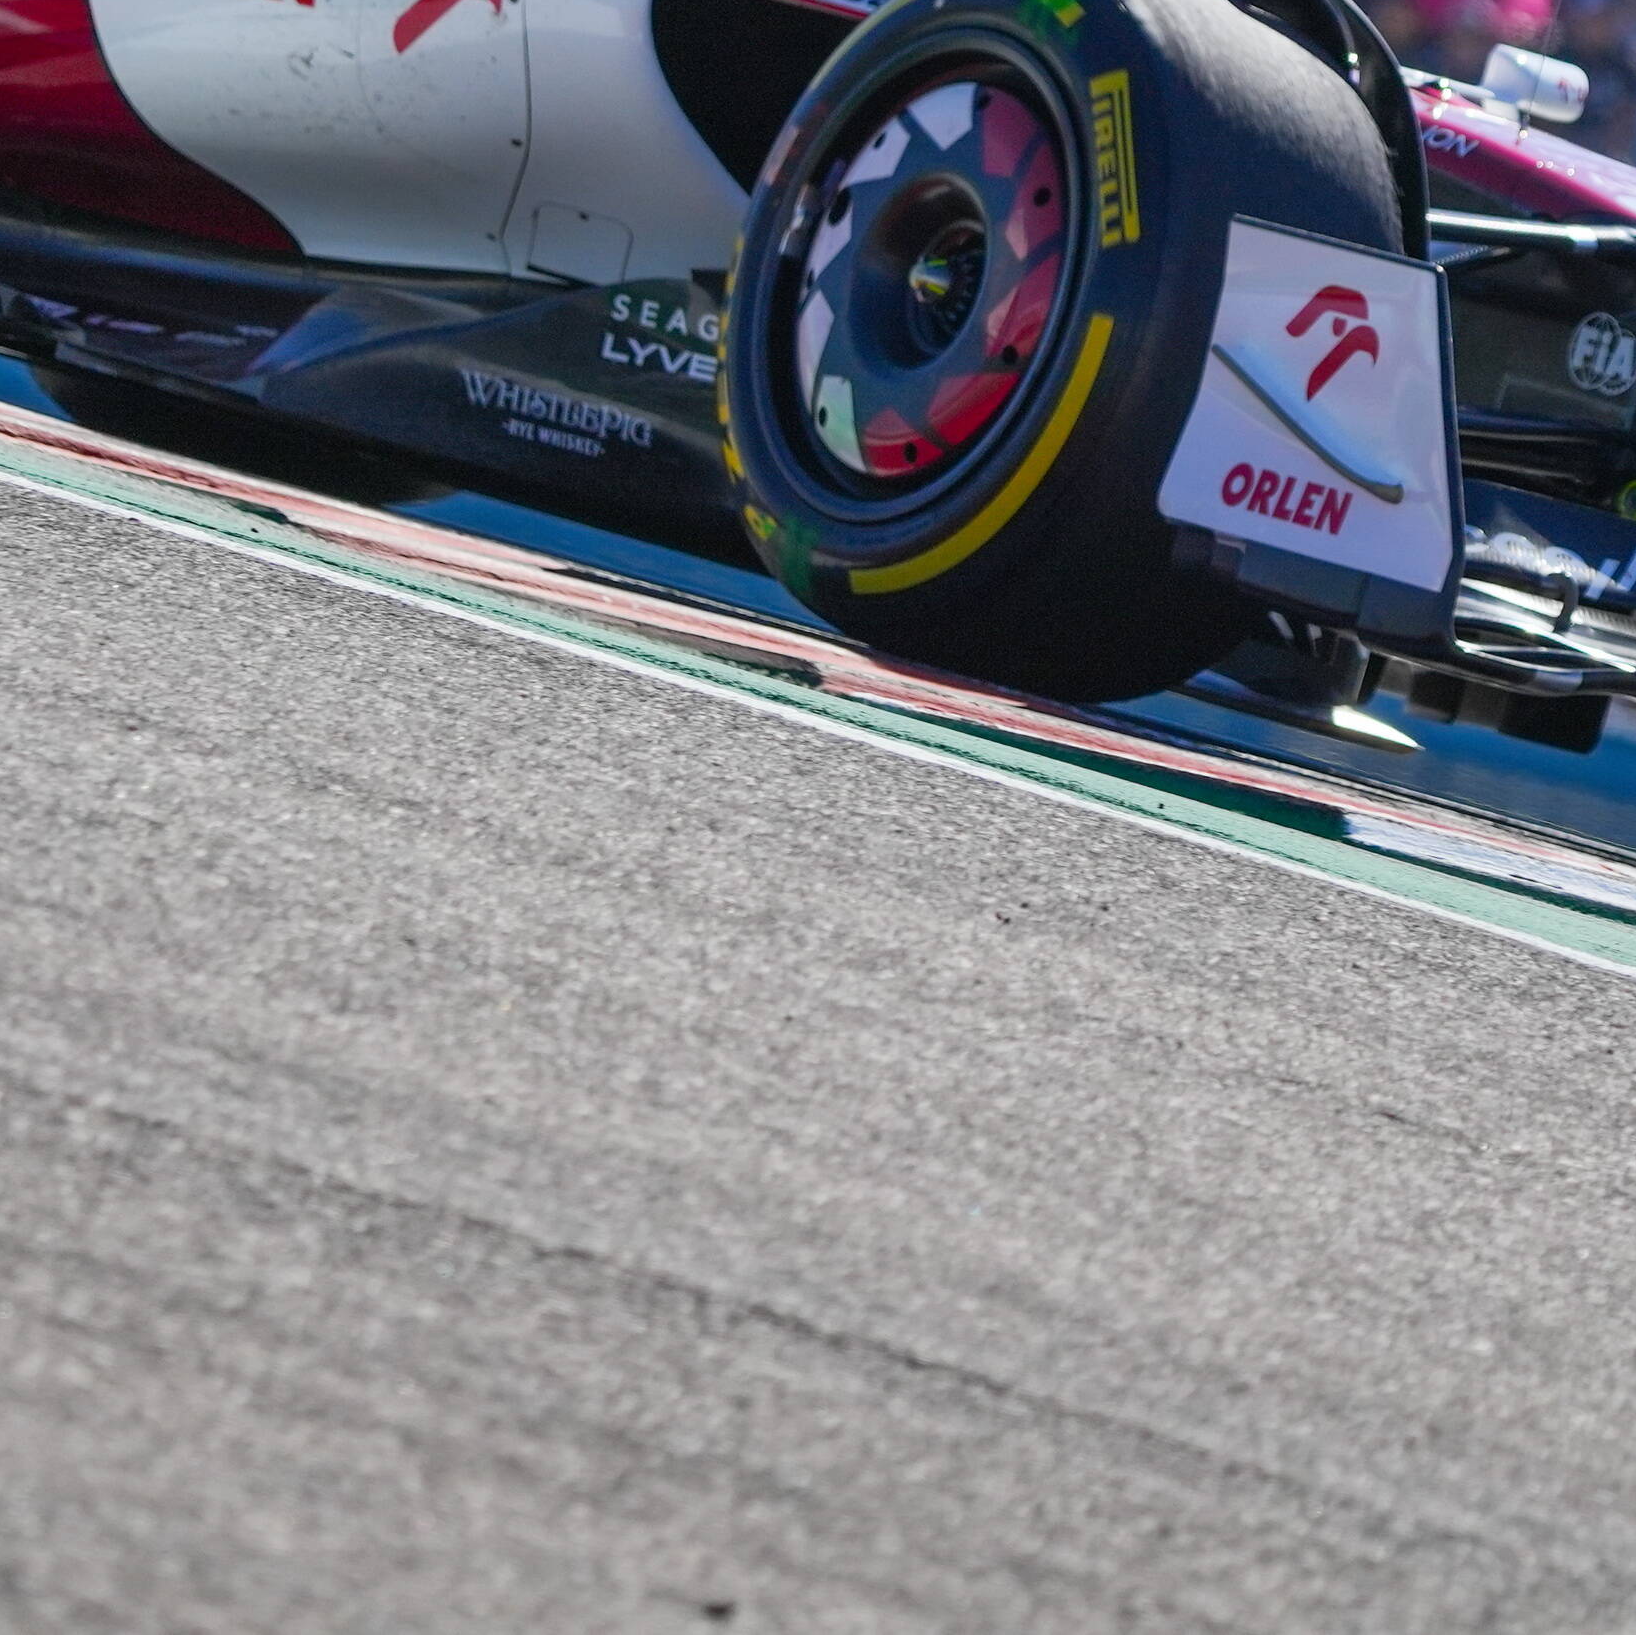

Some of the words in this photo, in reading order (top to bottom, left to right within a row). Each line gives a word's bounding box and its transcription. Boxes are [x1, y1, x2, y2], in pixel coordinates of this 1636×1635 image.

[1089, 69, 1141, 249] PIRELLI
[610, 293, 720, 343] SEAG
[600, 332, 718, 383] LYVE
[1221, 462, 1353, 536] ORLEN
